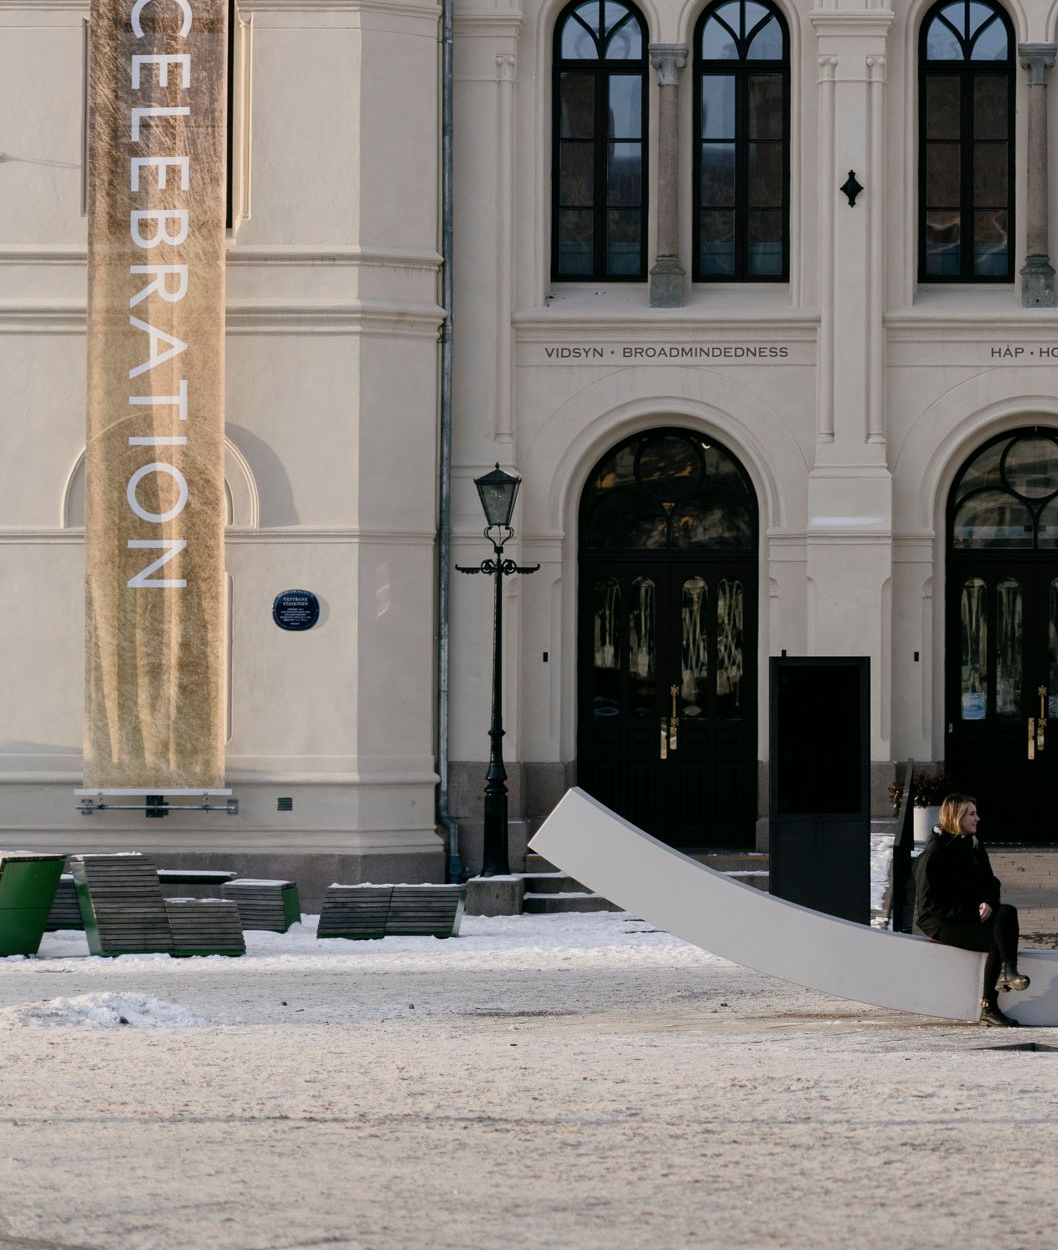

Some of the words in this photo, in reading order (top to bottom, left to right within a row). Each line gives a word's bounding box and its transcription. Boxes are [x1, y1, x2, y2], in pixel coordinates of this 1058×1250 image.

[544, 346, 604, 358] VIDSYN
[622, 346, 789, 358] BROADMINDEDNESS
[990, 344, 1025, 358] HÅP
